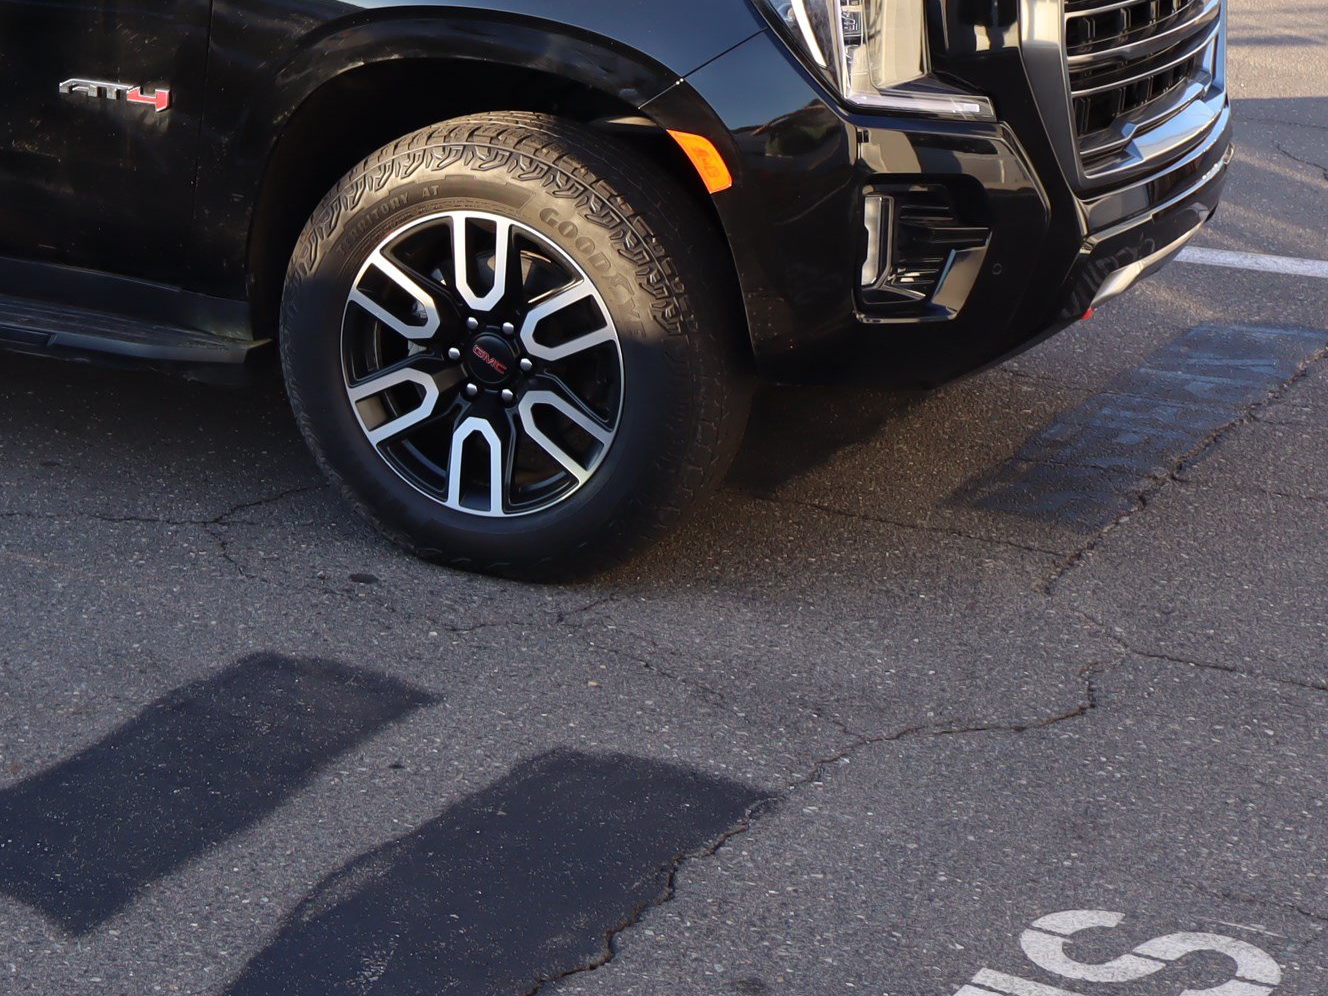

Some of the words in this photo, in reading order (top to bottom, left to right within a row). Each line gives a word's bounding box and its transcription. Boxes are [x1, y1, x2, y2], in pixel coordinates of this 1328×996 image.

[58, 78, 170, 112] AT4
[422, 184, 440, 198] AT
[539, 207, 648, 339] GOODYE
[472, 344, 508, 375] GMC
